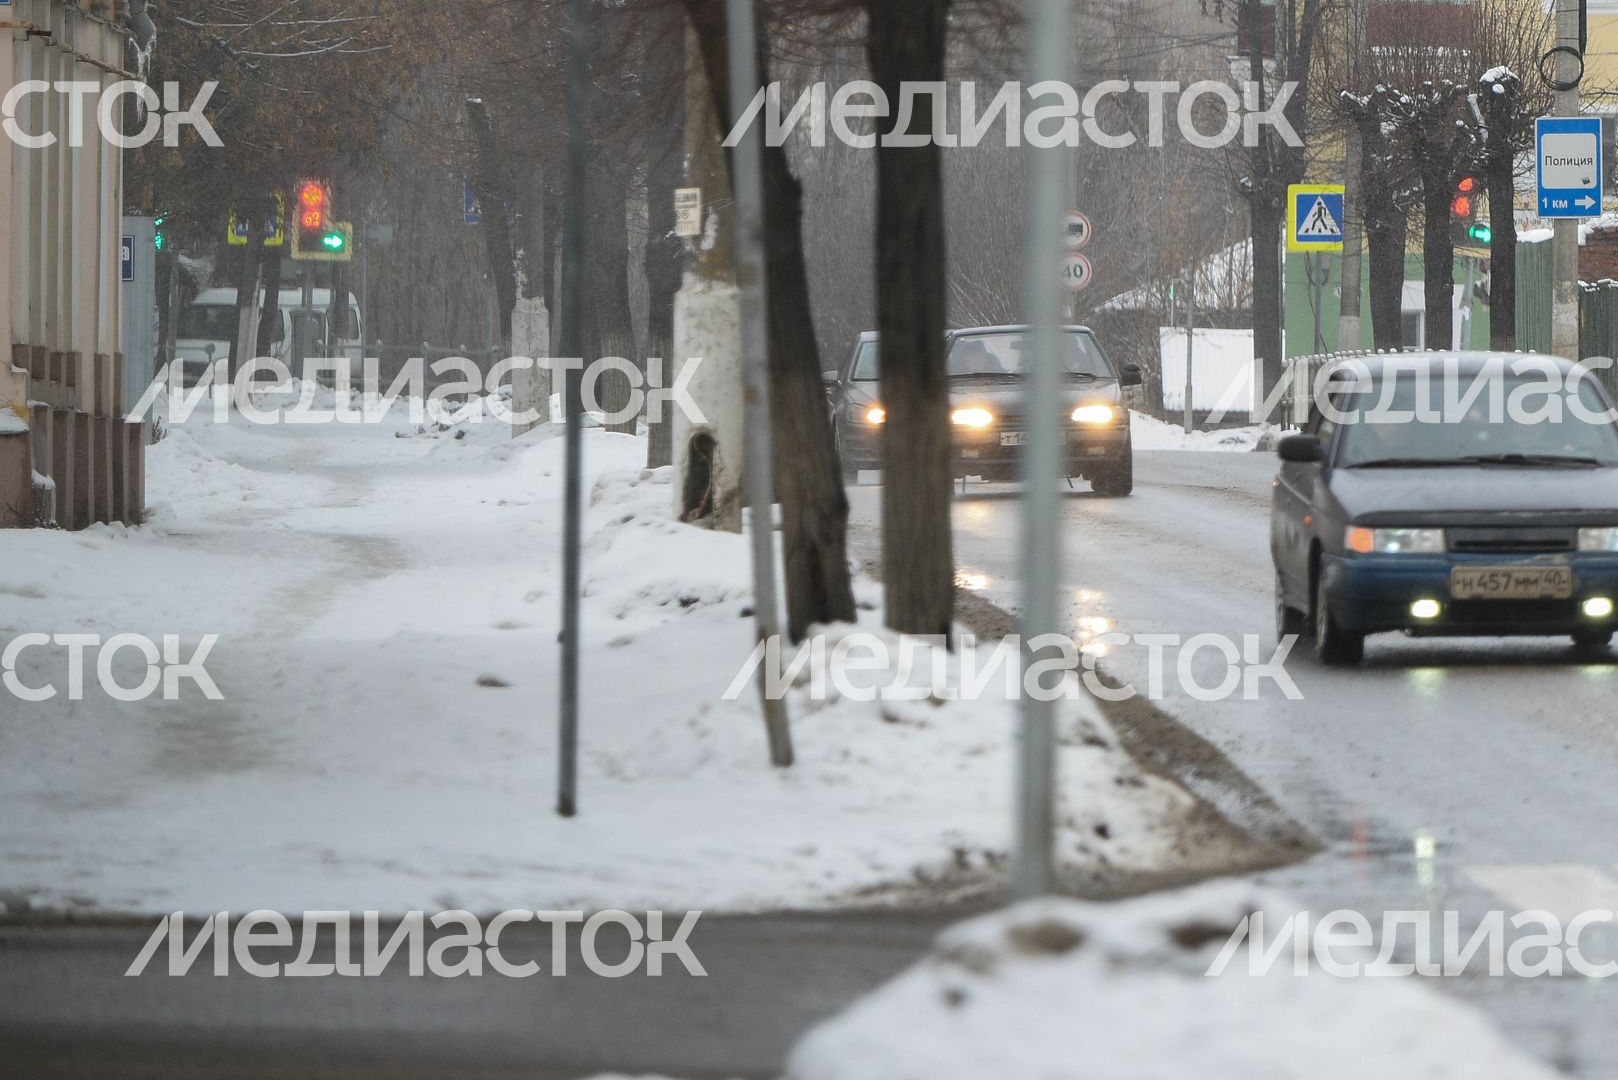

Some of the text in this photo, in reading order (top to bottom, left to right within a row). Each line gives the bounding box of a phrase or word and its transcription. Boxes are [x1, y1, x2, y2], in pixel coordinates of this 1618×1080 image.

[1545, 155, 1593, 167] Полиция
[1542, 197, 1548, 209] 1
[1062, 263, 1083, 279] 40
